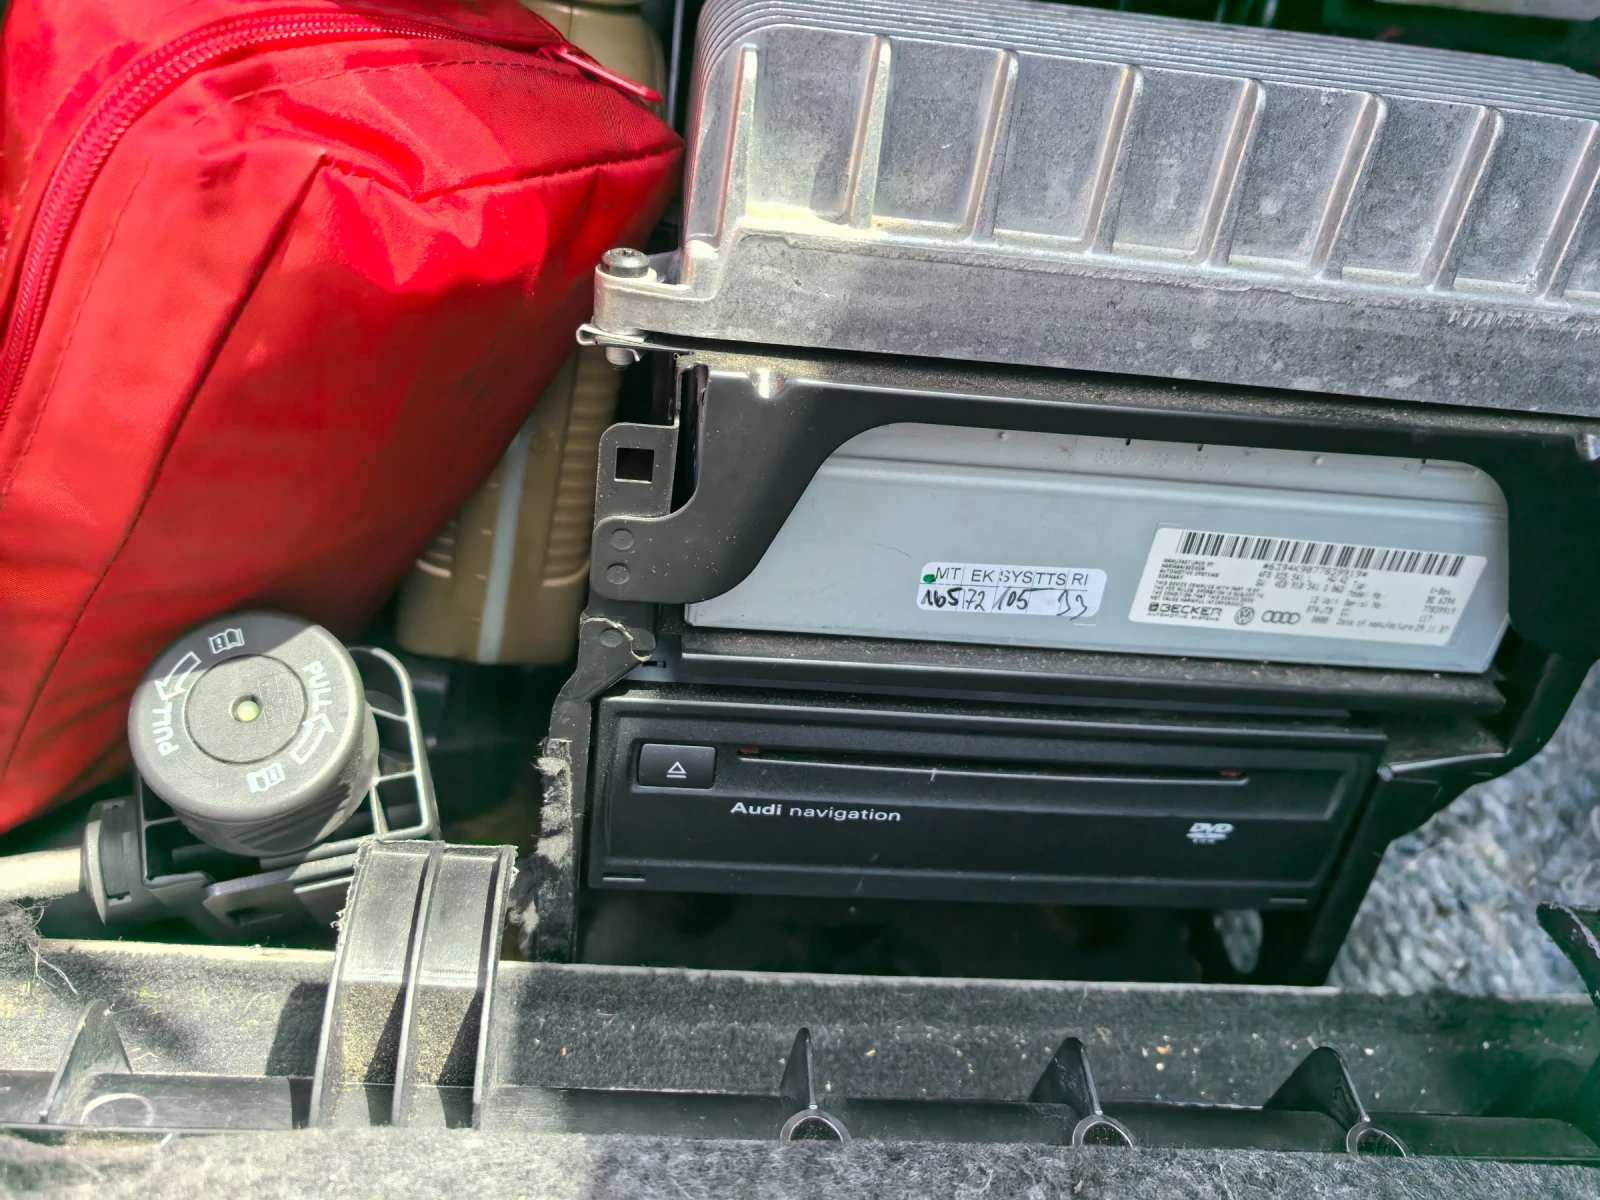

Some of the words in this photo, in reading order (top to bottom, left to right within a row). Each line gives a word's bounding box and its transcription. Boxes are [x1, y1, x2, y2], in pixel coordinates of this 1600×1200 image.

[936, 567, 962, 580] MT
[971, 569, 995, 583] EK
[999, 570, 1033, 584] SYS
[1036, 572, 1067, 586] TTS
[1071, 573, 1089, 586] RI
[1158, 603, 1222, 616] BECKER
[303, 660, 333, 712] PULL
[151, 701, 180, 757] PULL
[730, 802, 783, 816] Audi
[789, 807, 901, 821] navigation
